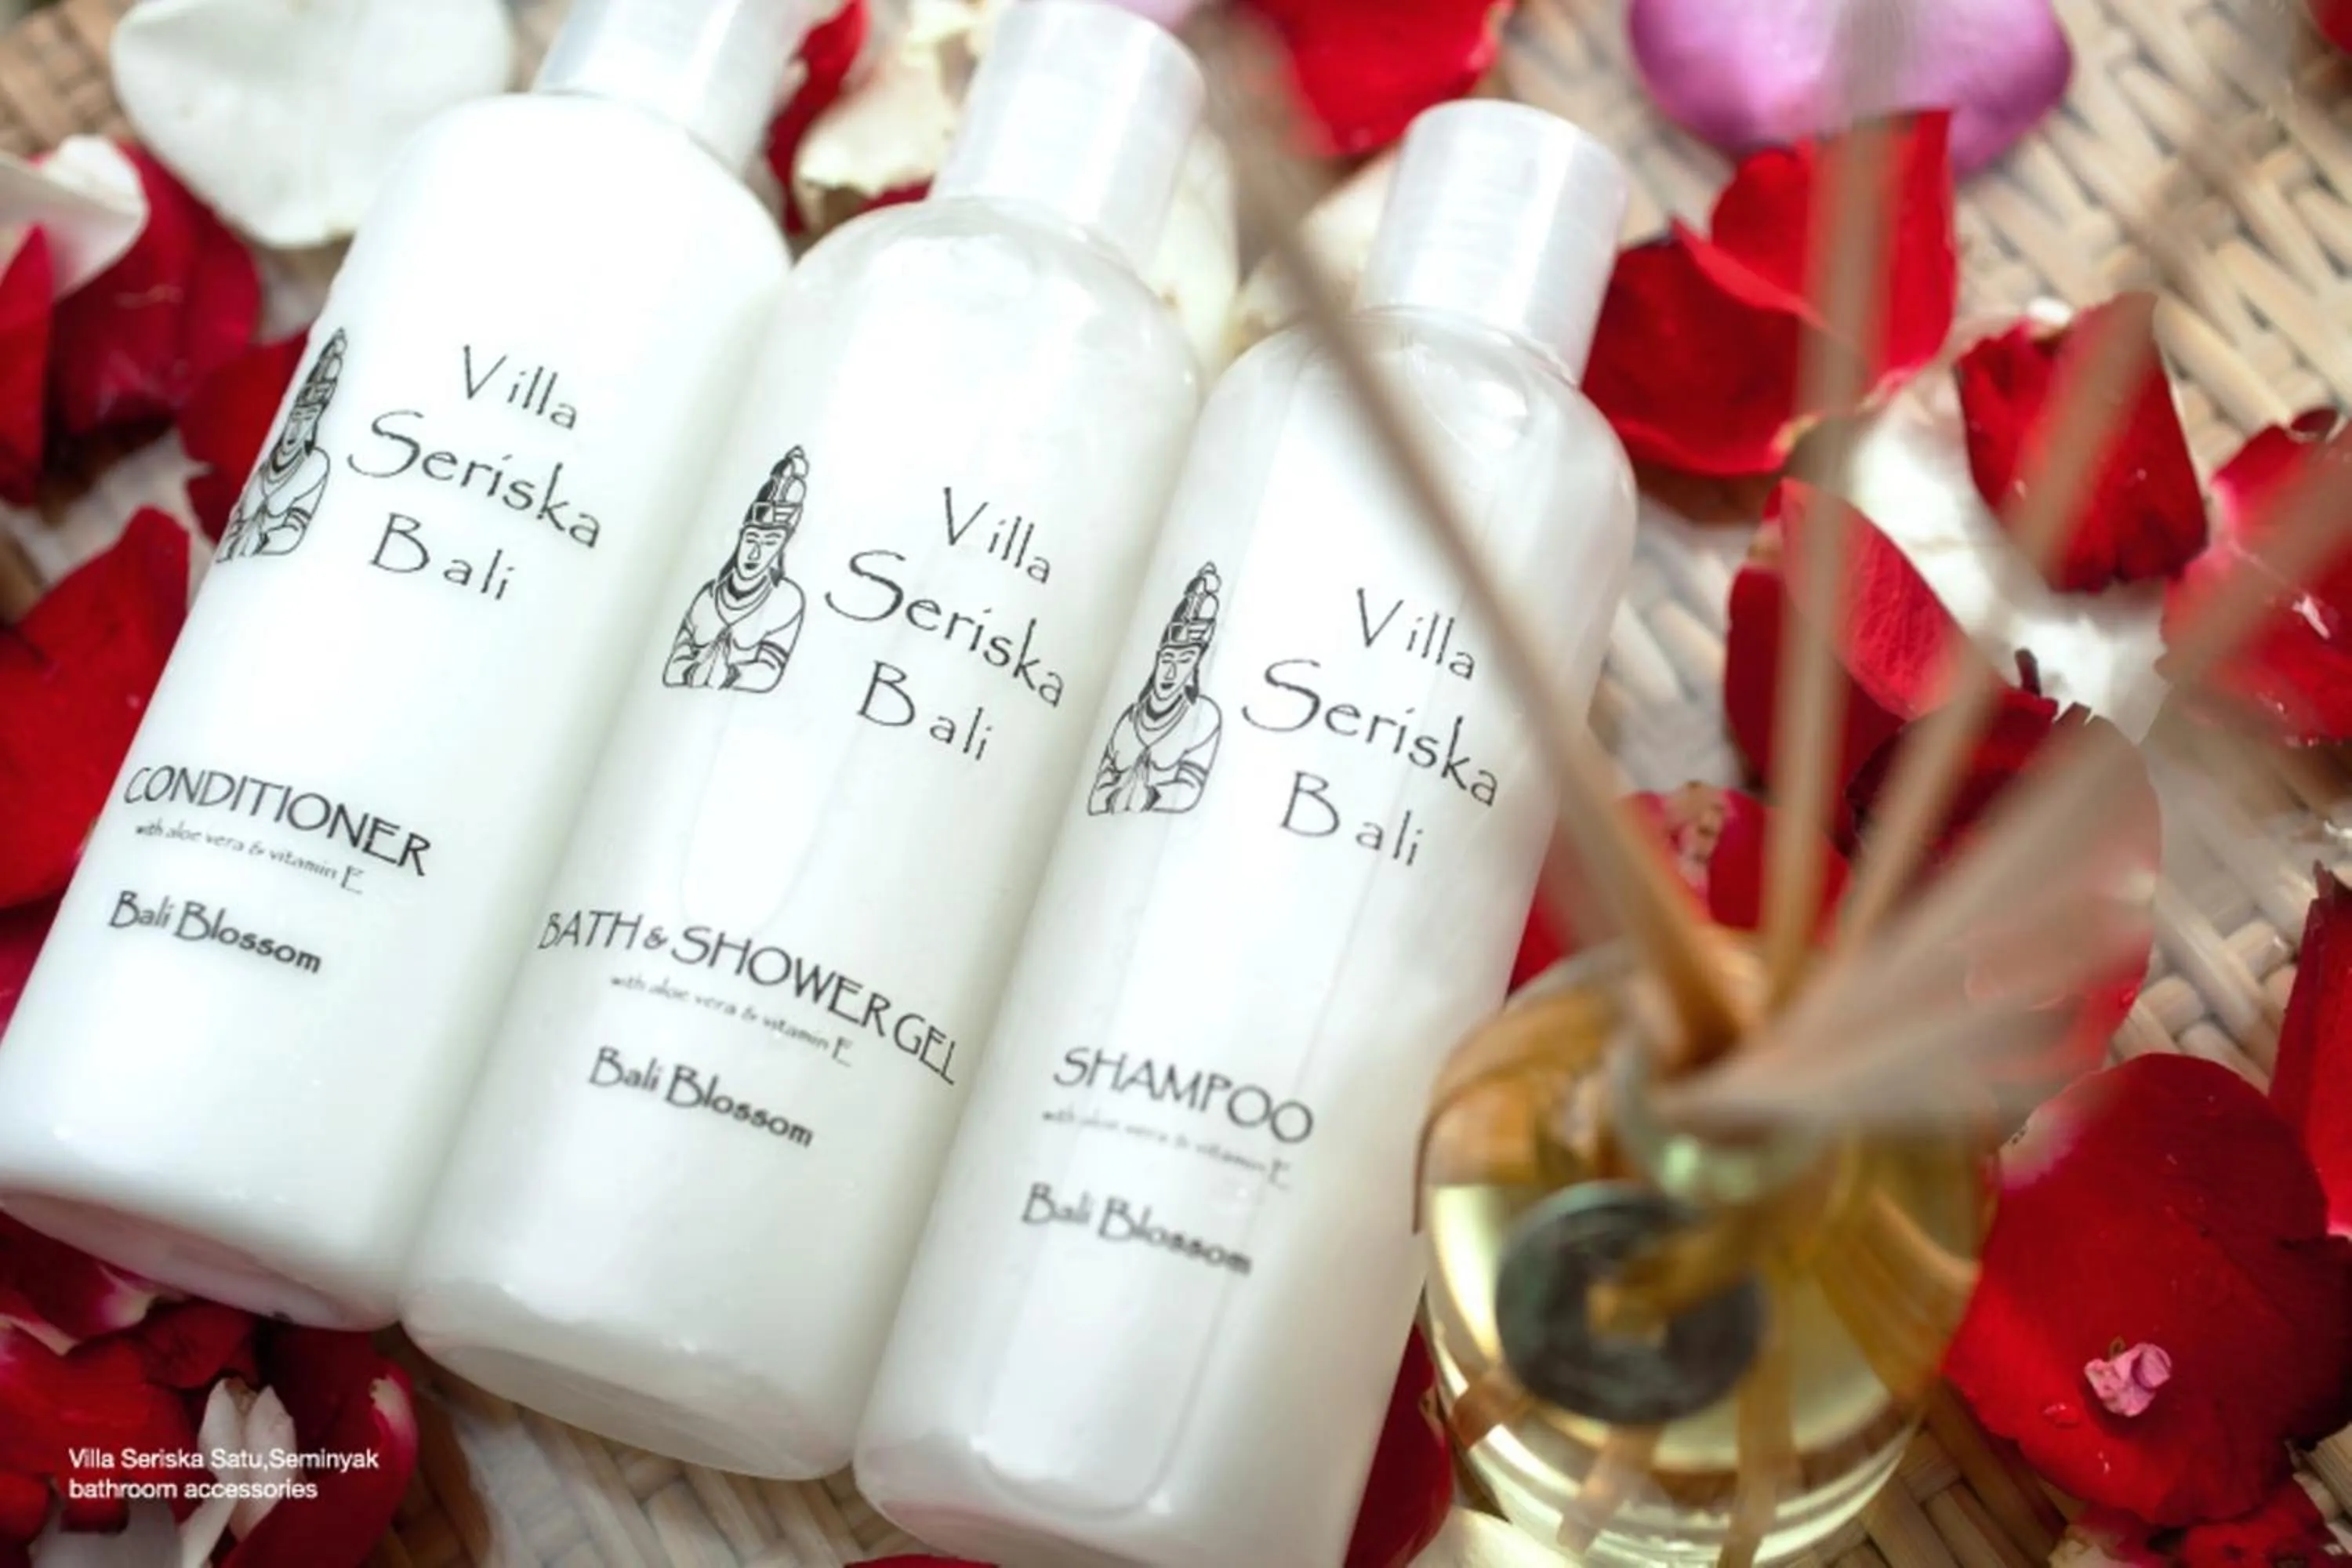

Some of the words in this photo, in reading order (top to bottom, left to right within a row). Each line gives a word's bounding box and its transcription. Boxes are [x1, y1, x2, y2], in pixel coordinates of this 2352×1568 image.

[463, 345, 577, 430] Villa
[347, 409, 601, 548] Seriska
[368, 512, 515, 600] Bali
[943, 487, 1051, 583] Villa
[825, 550, 1065, 707] Seriska
[1356, 587, 1475, 681] Villa
[857, 660, 993, 760] Bali
[1242, 659, 1498, 807] Seriska
[124, 765, 430, 876] CONDITIONER
[136, 818, 162, 836] with
[165, 820, 202, 841] aloe
[205, 832, 244, 854] vera
[249, 841, 265, 855] &
[269, 848, 338, 880] vitamin
[340, 865, 364, 895] E
[1280, 770, 1423, 866] Bali
[108, 890, 175, 928] Bali
[173, 900, 322, 973] Blossom
[539, 910, 644, 949] BATH
[643, 926, 668, 950] &
[671, 926, 892, 1037] SHOWER
[894, 1013, 957, 1085] GEL
[611, 974, 645, 992] with
[648, 978, 690, 1001] aloe
[694, 993, 736, 1016] vera
[762, 1013, 829, 1051] vitamin
[833, 1036, 852, 1067] E
[589, 1045, 661, 1091] Bali
[666, 1064, 814, 1148] Blossom
[1054, 1046, 1313, 1145] SHAMPOO
[1022, 1182, 1092, 1224] Bali
[1098, 1196, 1252, 1276] Blossom
